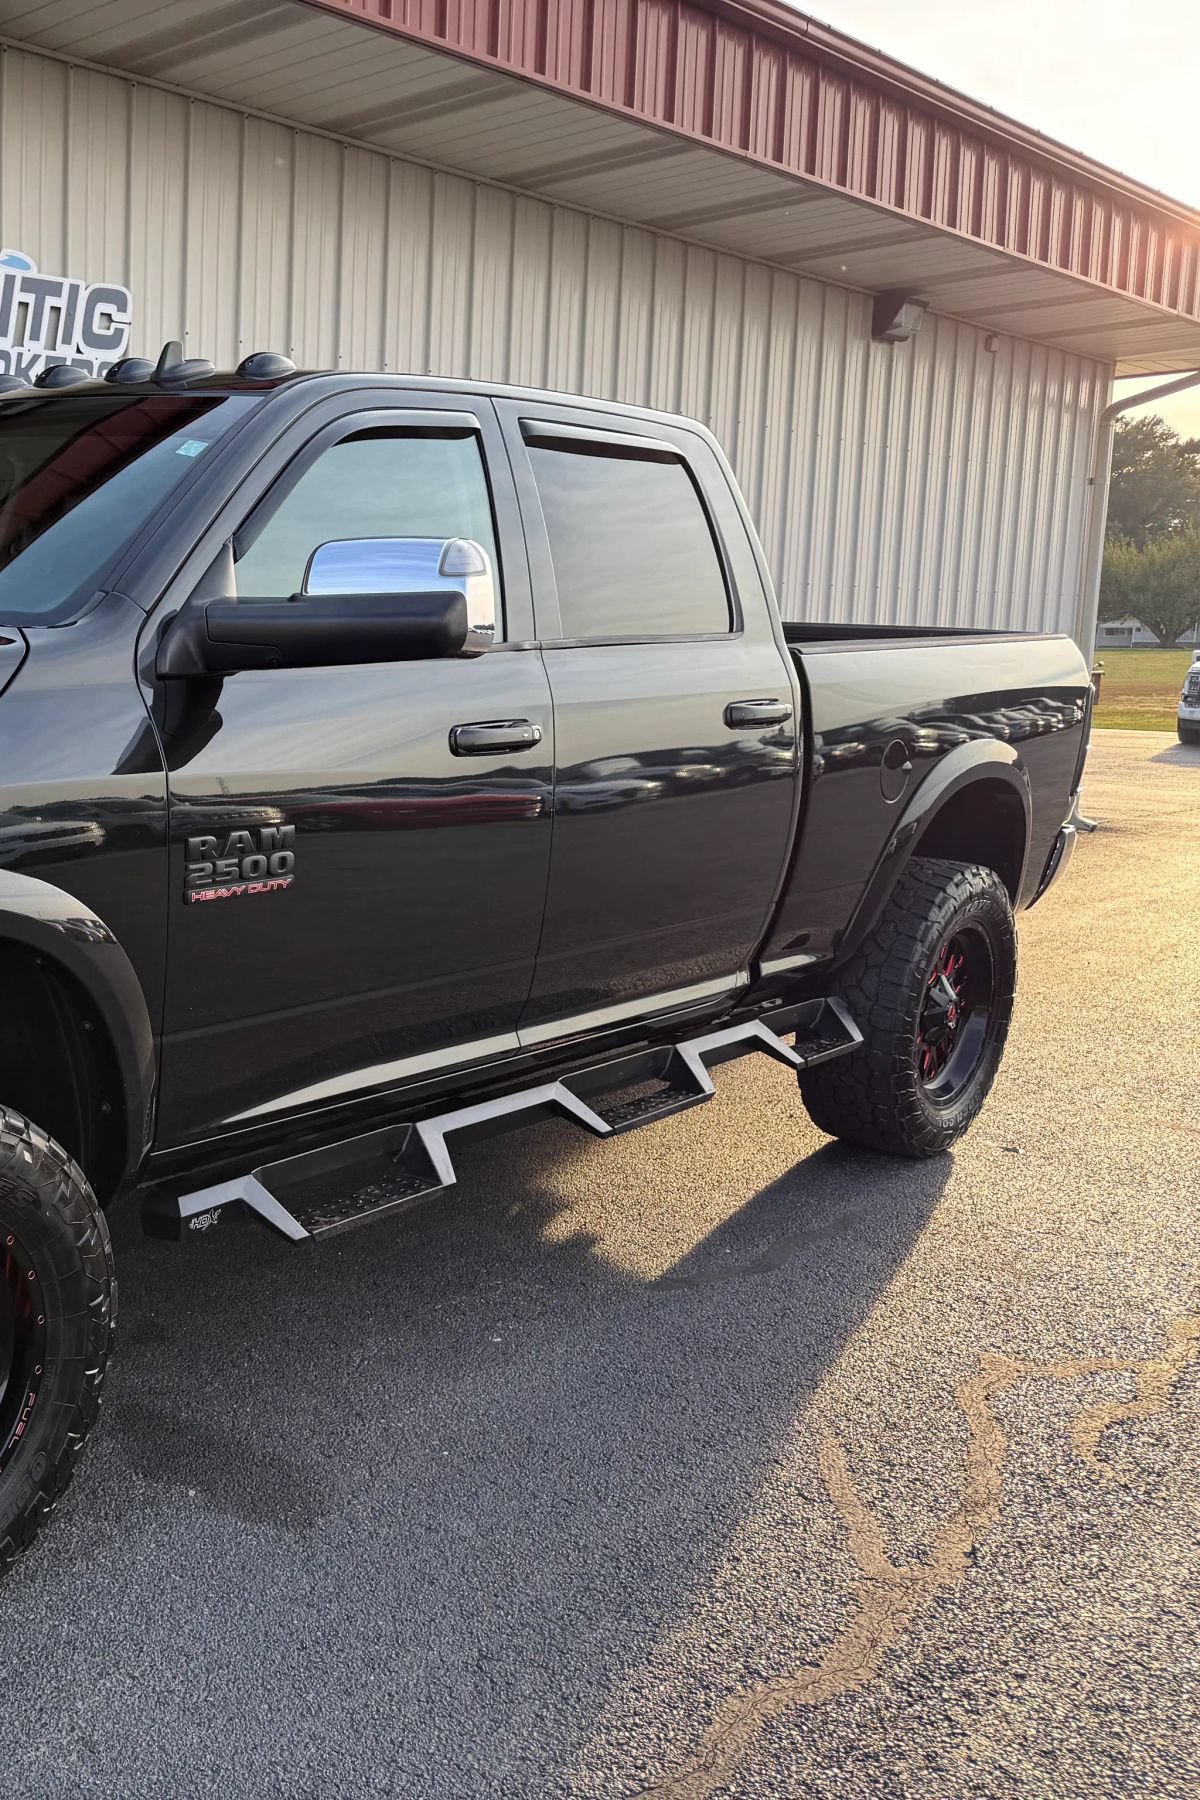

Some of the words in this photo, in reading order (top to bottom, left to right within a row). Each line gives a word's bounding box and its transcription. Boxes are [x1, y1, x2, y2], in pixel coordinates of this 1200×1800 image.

[185, 824, 296, 861] RAM
[184, 850, 296, 889] 2500
[191, 885, 247, 903] HEAVY
[247, 878, 293, 895] DUTY
[8, 1391, 36, 1449] FUEL
